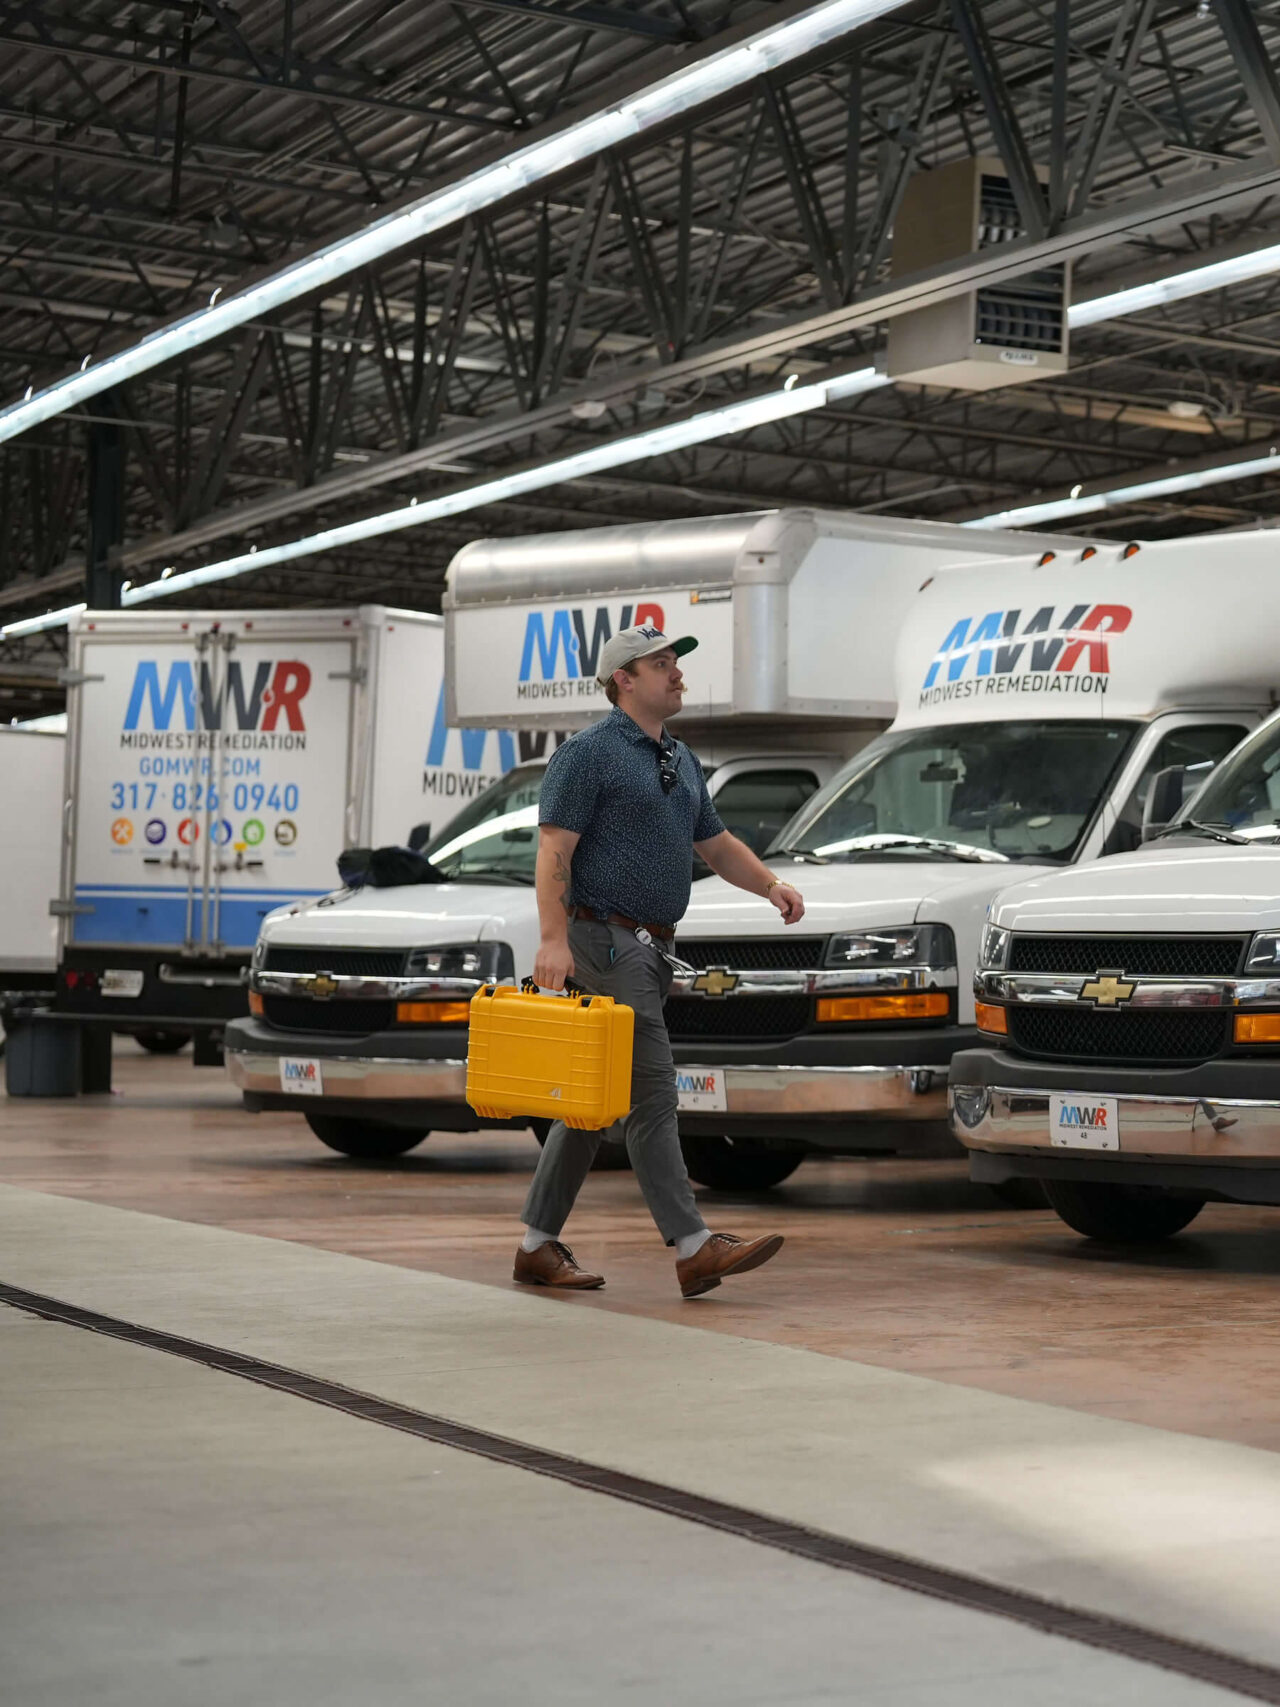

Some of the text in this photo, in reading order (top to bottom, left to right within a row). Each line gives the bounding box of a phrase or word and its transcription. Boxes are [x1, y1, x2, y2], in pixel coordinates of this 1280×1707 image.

[923, 604, 1132, 689] MWR
[123, 661, 311, 731] MWR
[517, 682, 575, 699] MIDWEST
[919, 675, 1109, 709] MIDWEST REMEDIATION
[120, 733, 306, 750] MIDWEST REMEDIATION
[139, 757, 261, 776] GOMWR.COM
[285, 1063, 316, 1079] MWR
[677, 1076, 716, 1092] MWR
[1060, 1106, 1107, 1127] MWR
